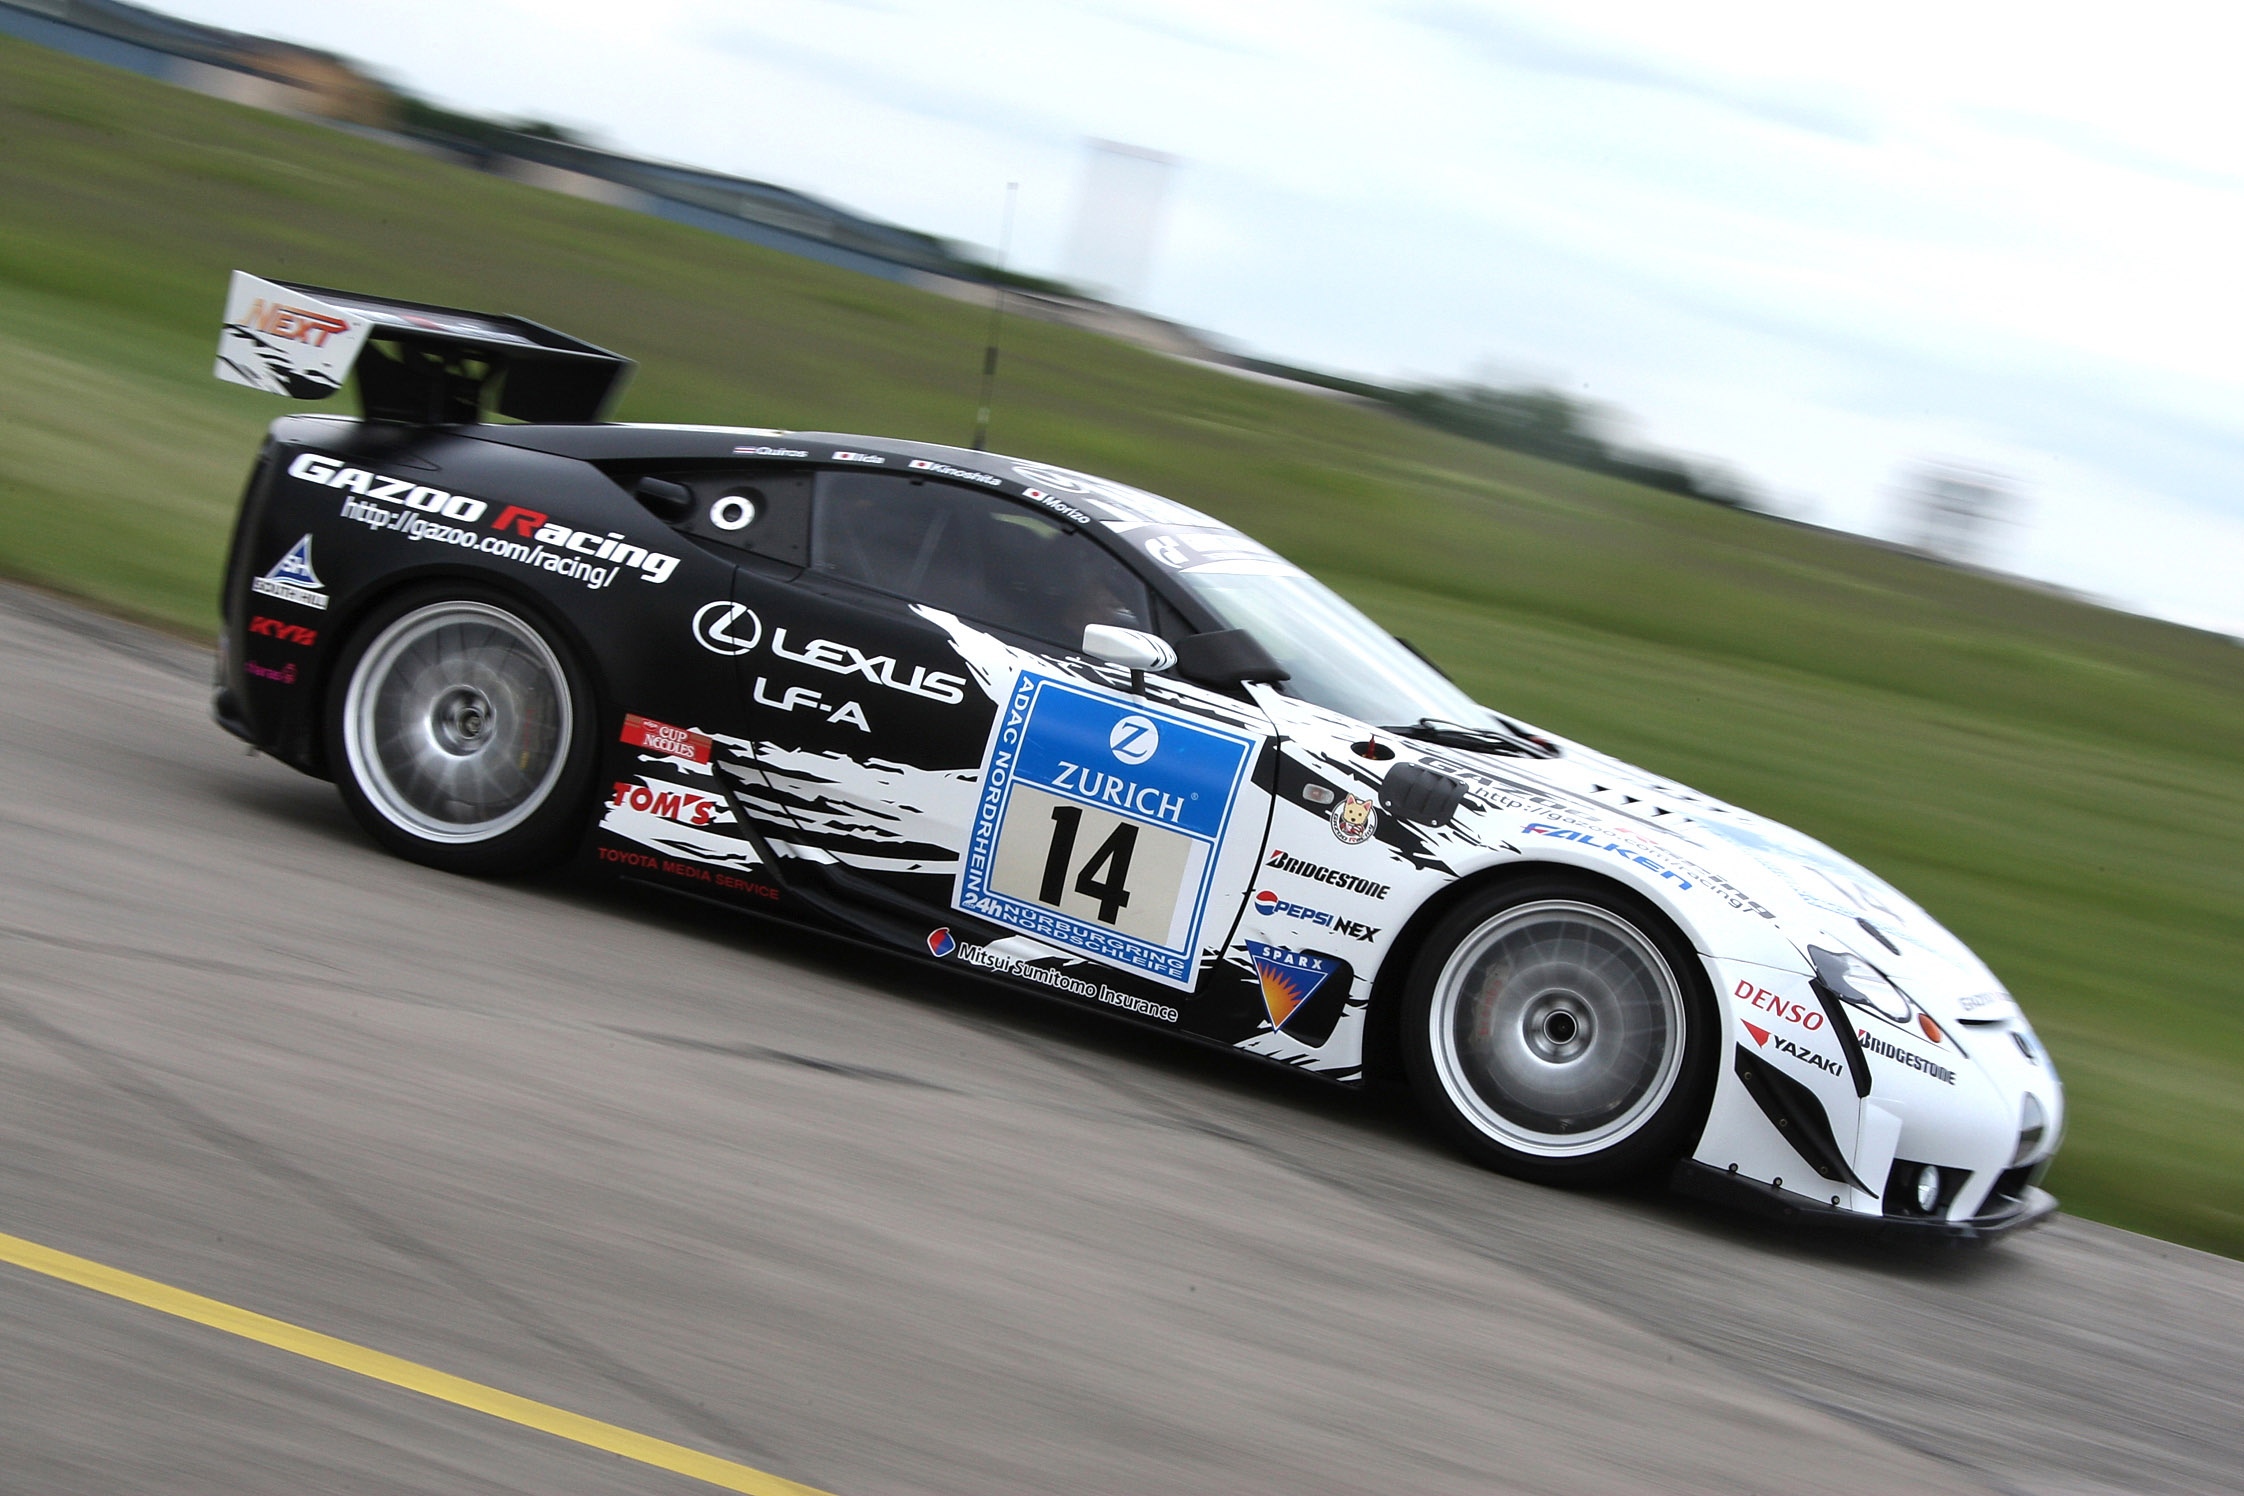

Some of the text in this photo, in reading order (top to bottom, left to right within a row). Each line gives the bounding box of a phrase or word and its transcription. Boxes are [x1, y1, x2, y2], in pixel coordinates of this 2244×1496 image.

[930, 463, 1002, 486] Kinoshita
[287, 453, 682, 584] GAZOO Racing
[1042, 495, 1091, 524] Morizo
[340, 496, 620, 590] http://gazoo.com/racing/
[771, 627, 967, 705] LEXUS
[753, 676, 872, 733] LF-A
[1003, 676, 1034, 745] ADAC
[658, 726, 688, 742] CUP
[612, 781, 714, 825] TOM'S
[1051, 760, 1185, 823] ZURICH
[967, 750, 1009, 892] NORDRHEIN
[598, 847, 780, 900] TOYOTA MEDIA SERVICE
[1037, 805, 1140, 925] 14
[1265, 849, 1391, 900] BRIDGESTONE
[1521, 822, 1693, 891] FALKEN
[961, 893, 1185, 969] 24h NÜRBURGRING
[1003, 914, 1184, 979] NORDSCHLEIFE
[1273, 900, 1382, 943] PEPSI NEX
[958, 942, 1179, 1022] Mitsui Sumitomo Insurance
[1262, 946, 1323, 970] SPARX
[1734, 979, 1824, 1032] DENSO
[1773, 1035, 1844, 1078] YAZAKI
[1857, 1028, 1957, 1086] BRIDGESTONE
